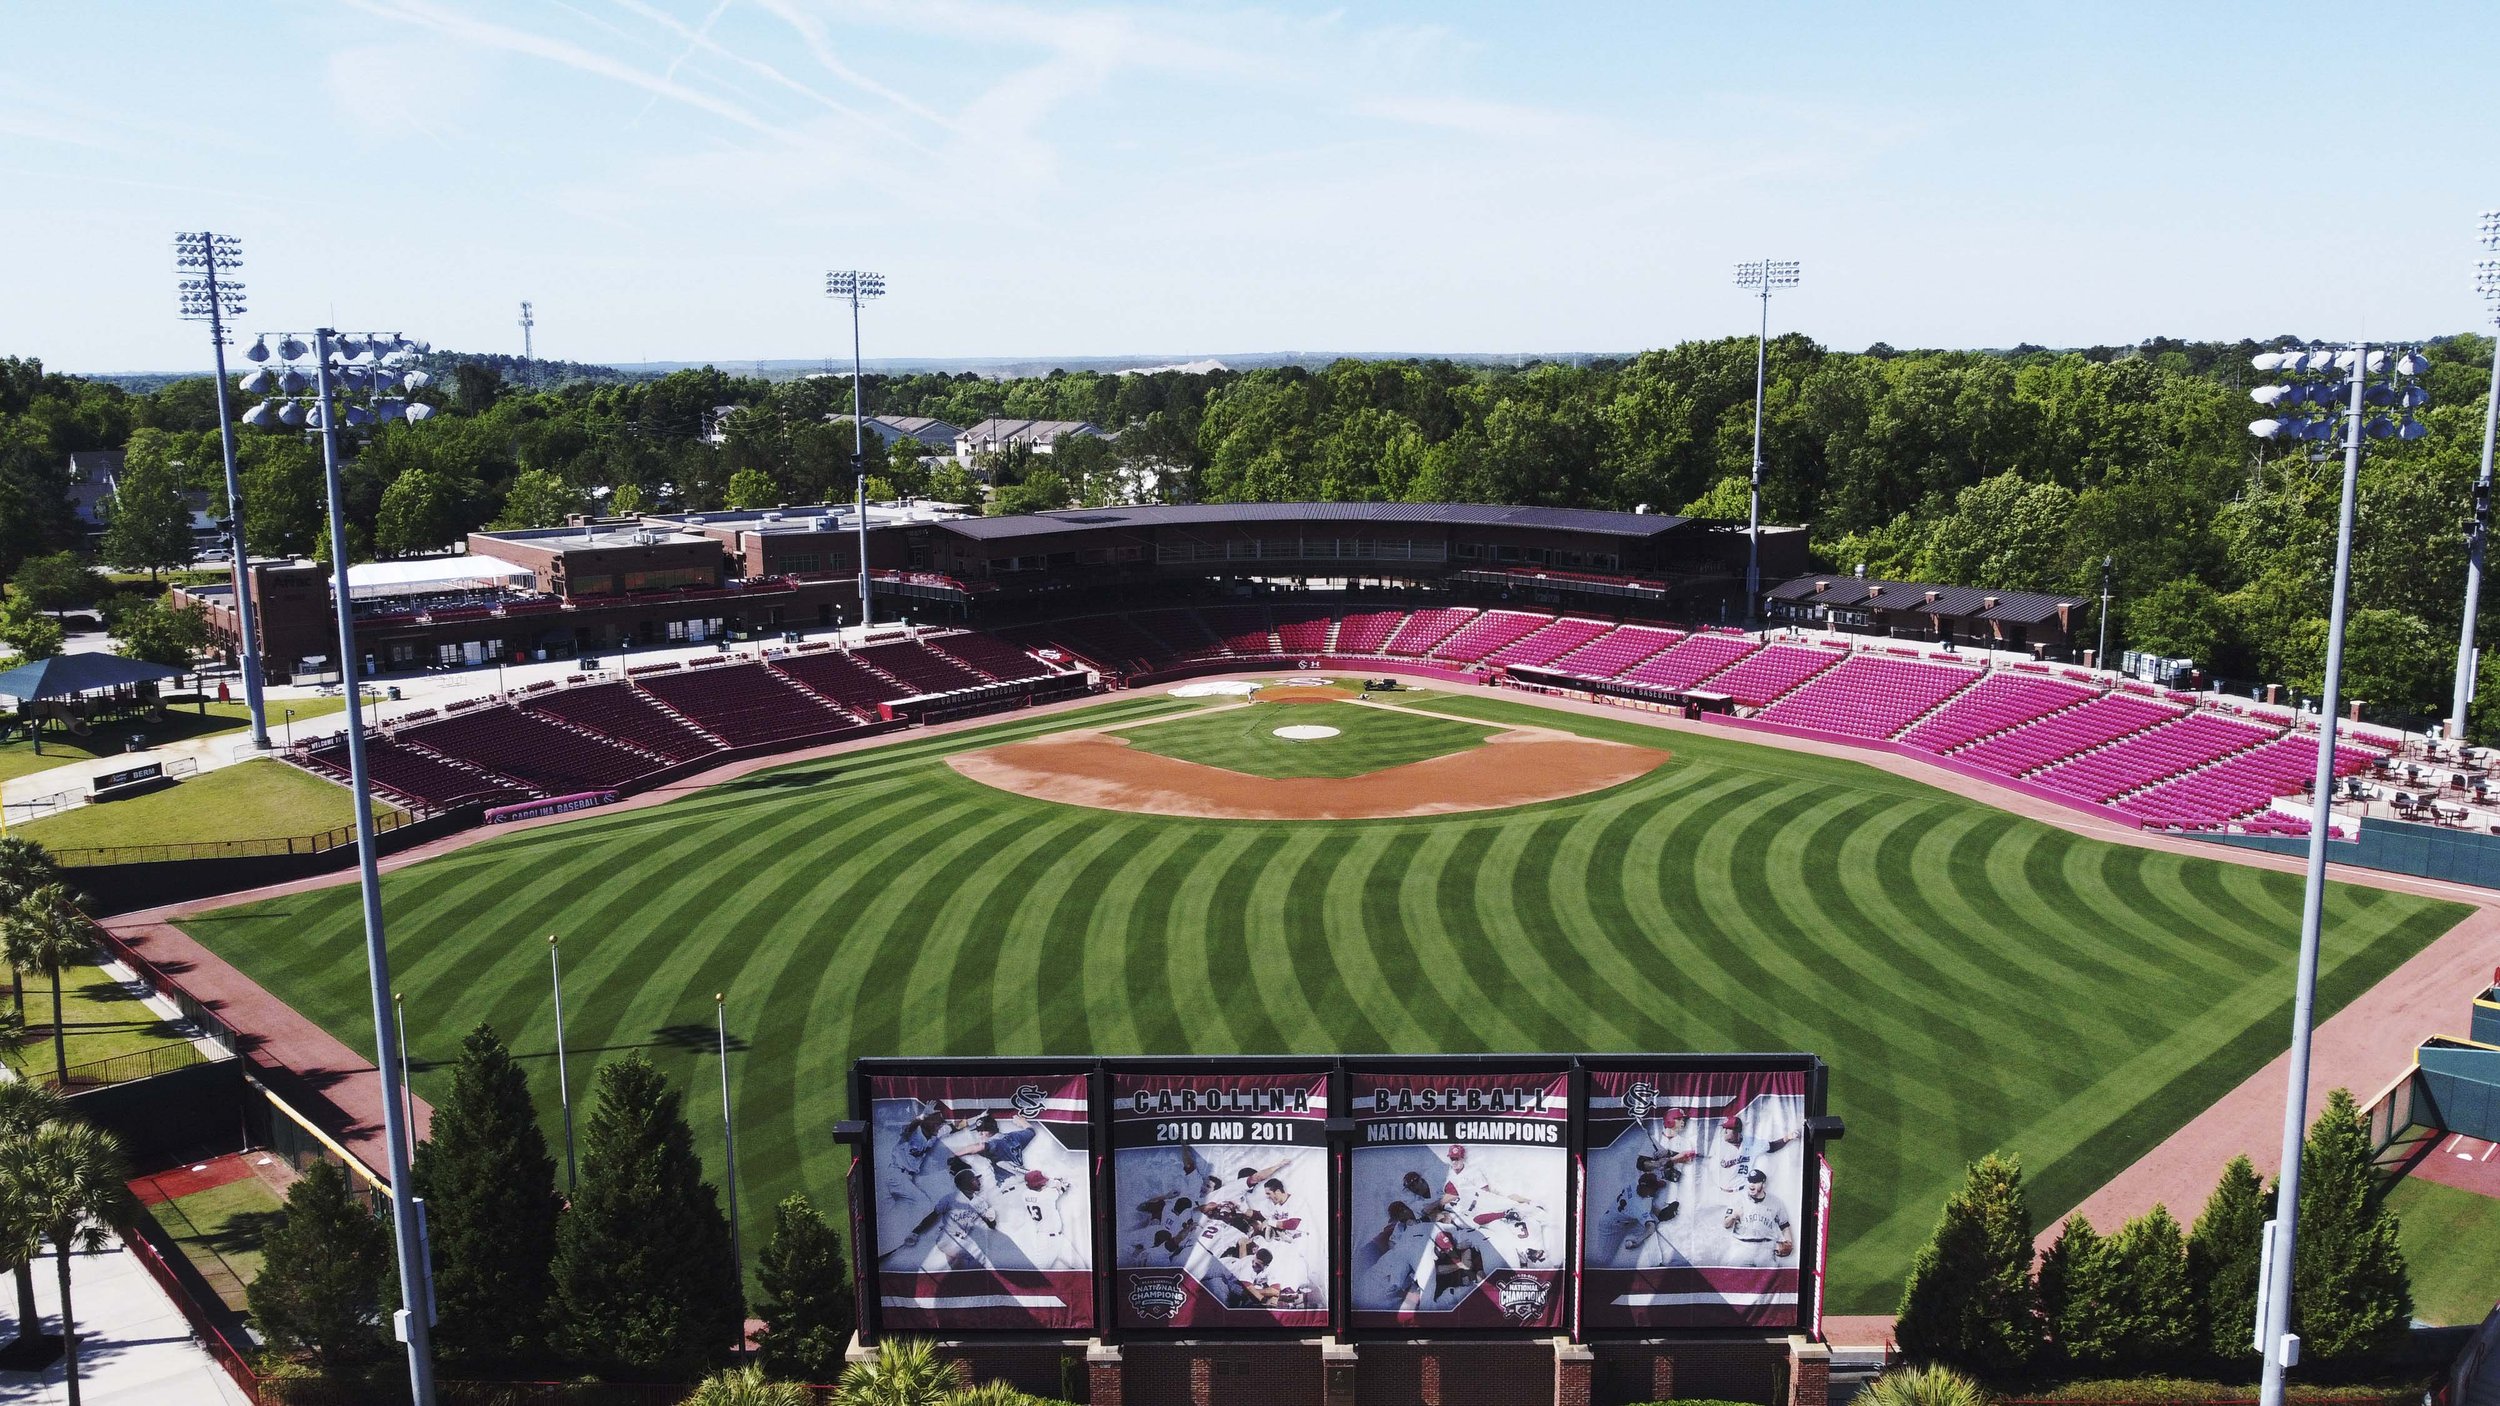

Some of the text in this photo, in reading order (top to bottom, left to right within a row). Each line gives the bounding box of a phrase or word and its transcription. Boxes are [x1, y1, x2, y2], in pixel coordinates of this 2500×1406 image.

[133, 768, 155, 779] BERM
[557, 797, 600, 813] BASEBALL
[1133, 1088, 1310, 1114] CAROLINA
[1374, 1087, 1548, 1113] BASEBALL
[1157, 1122, 1293, 1142] 2010 AND 2011
[1367, 1121, 1558, 1142] NATIONAL CHAMPIONS
[1737, 1165, 1749, 1175] 29
[1026, 1204, 1043, 1222] 13
[1202, 1226, 1219, 1239] 2
[1514, 1221, 1530, 1239] 3
[1136, 1283, 1178, 1292] NATIONAL
[1131, 1291, 1183, 1301] CHAMPIONS
[1500, 1290, 1547, 1305] CHAMPIONS
